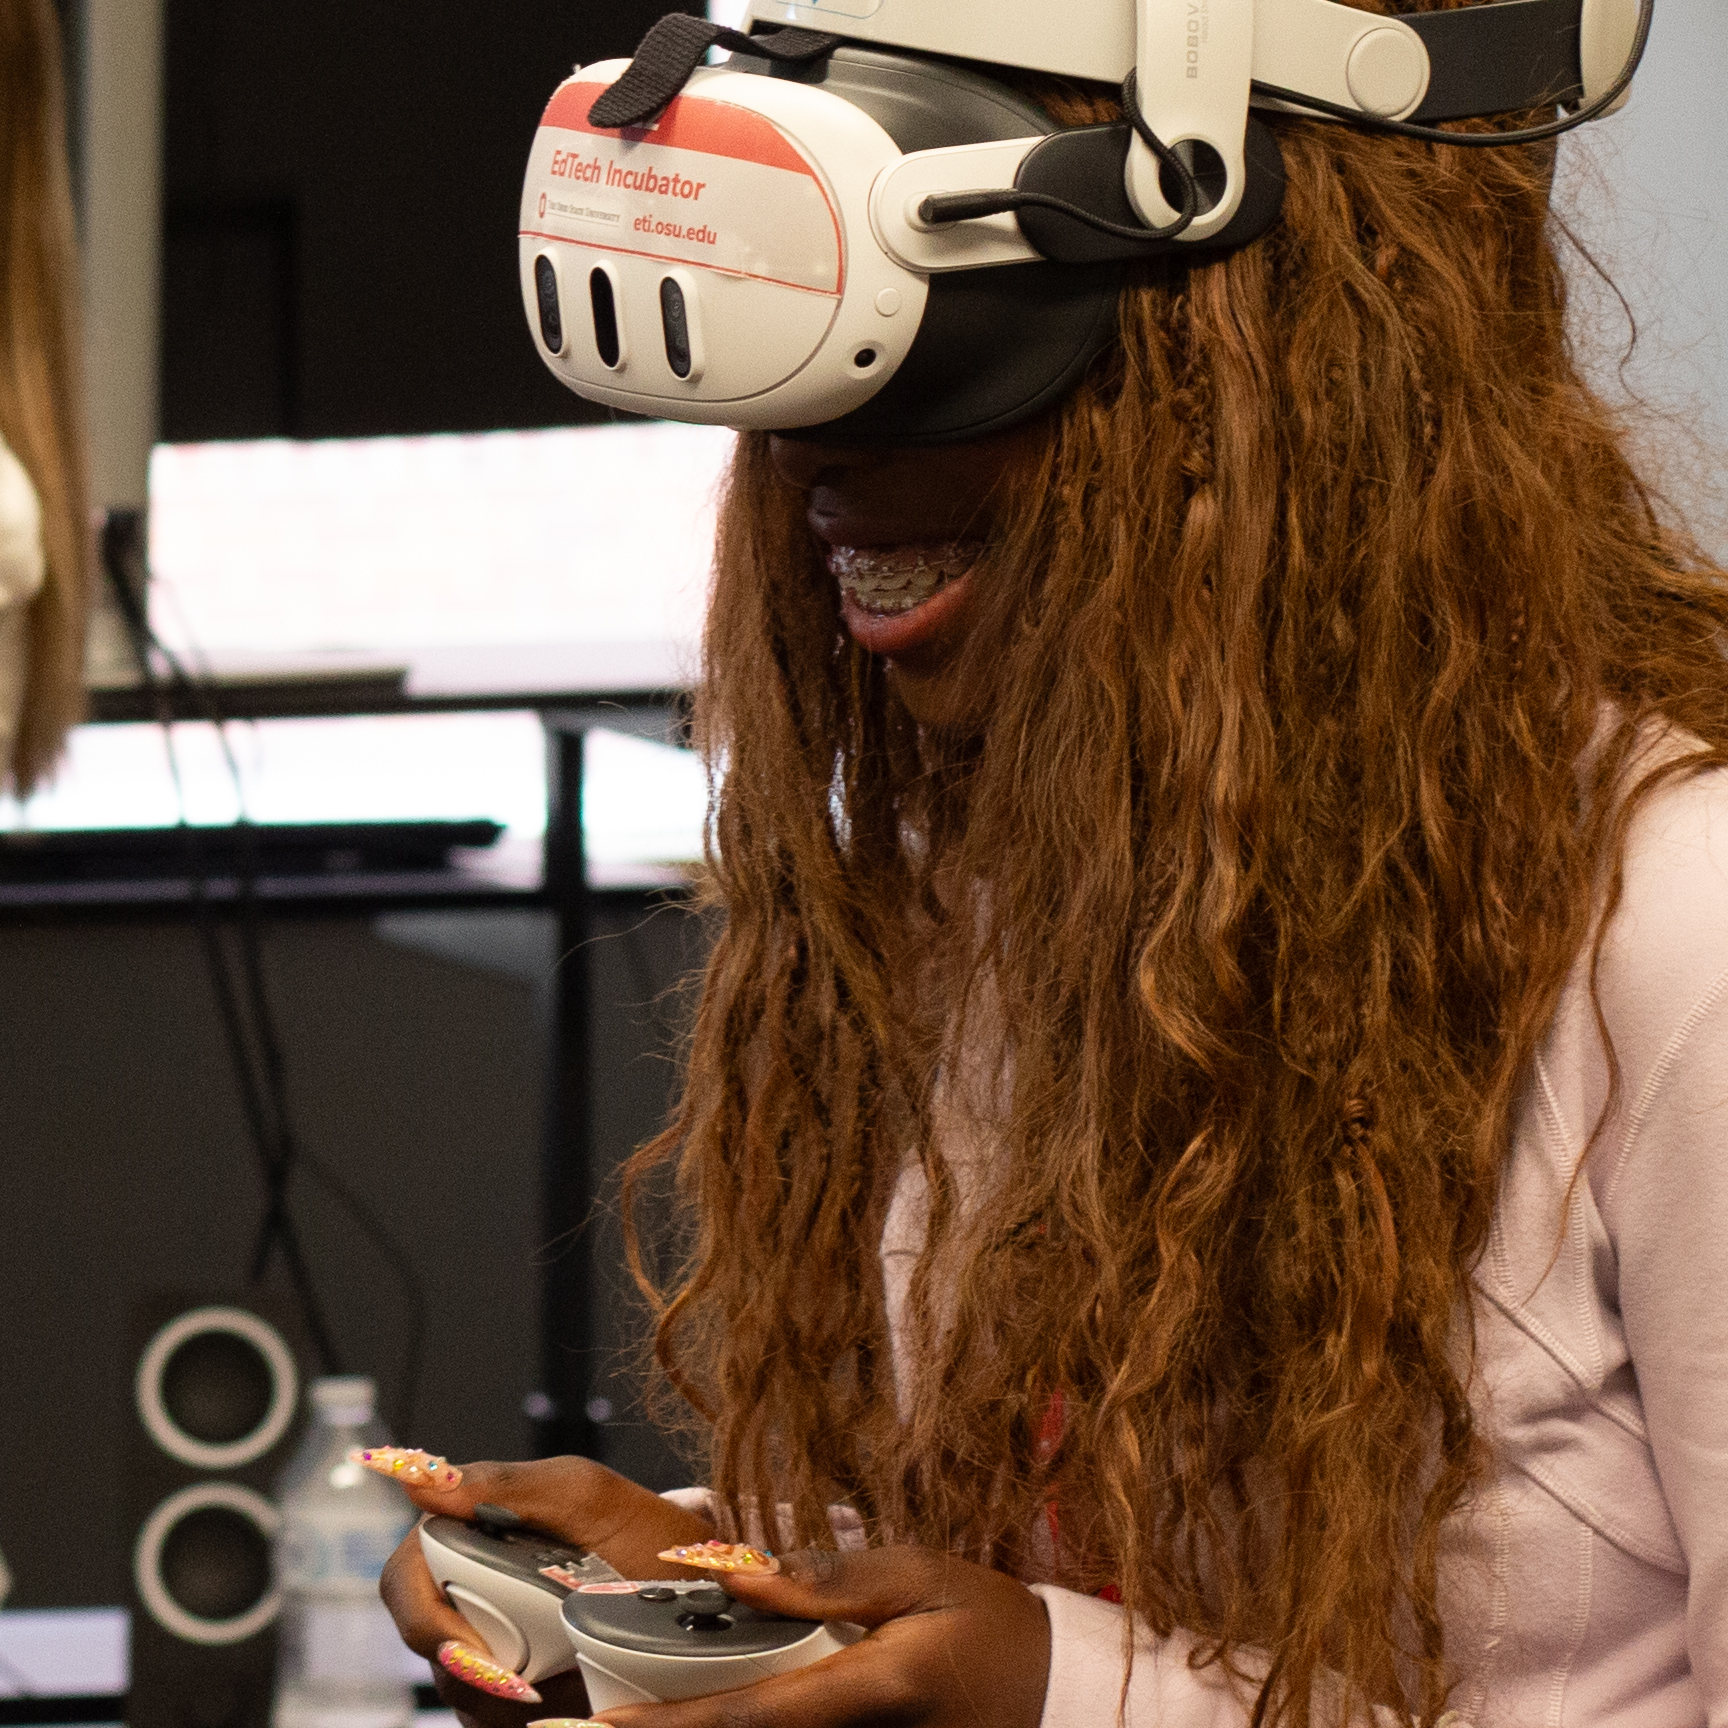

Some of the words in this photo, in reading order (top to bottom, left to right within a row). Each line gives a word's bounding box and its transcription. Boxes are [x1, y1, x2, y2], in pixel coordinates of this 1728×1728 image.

[551, 150, 601, 184] EdTech
[605, 160, 706, 200] Incubator
[633, 214, 718, 245] eti.osu.edu
